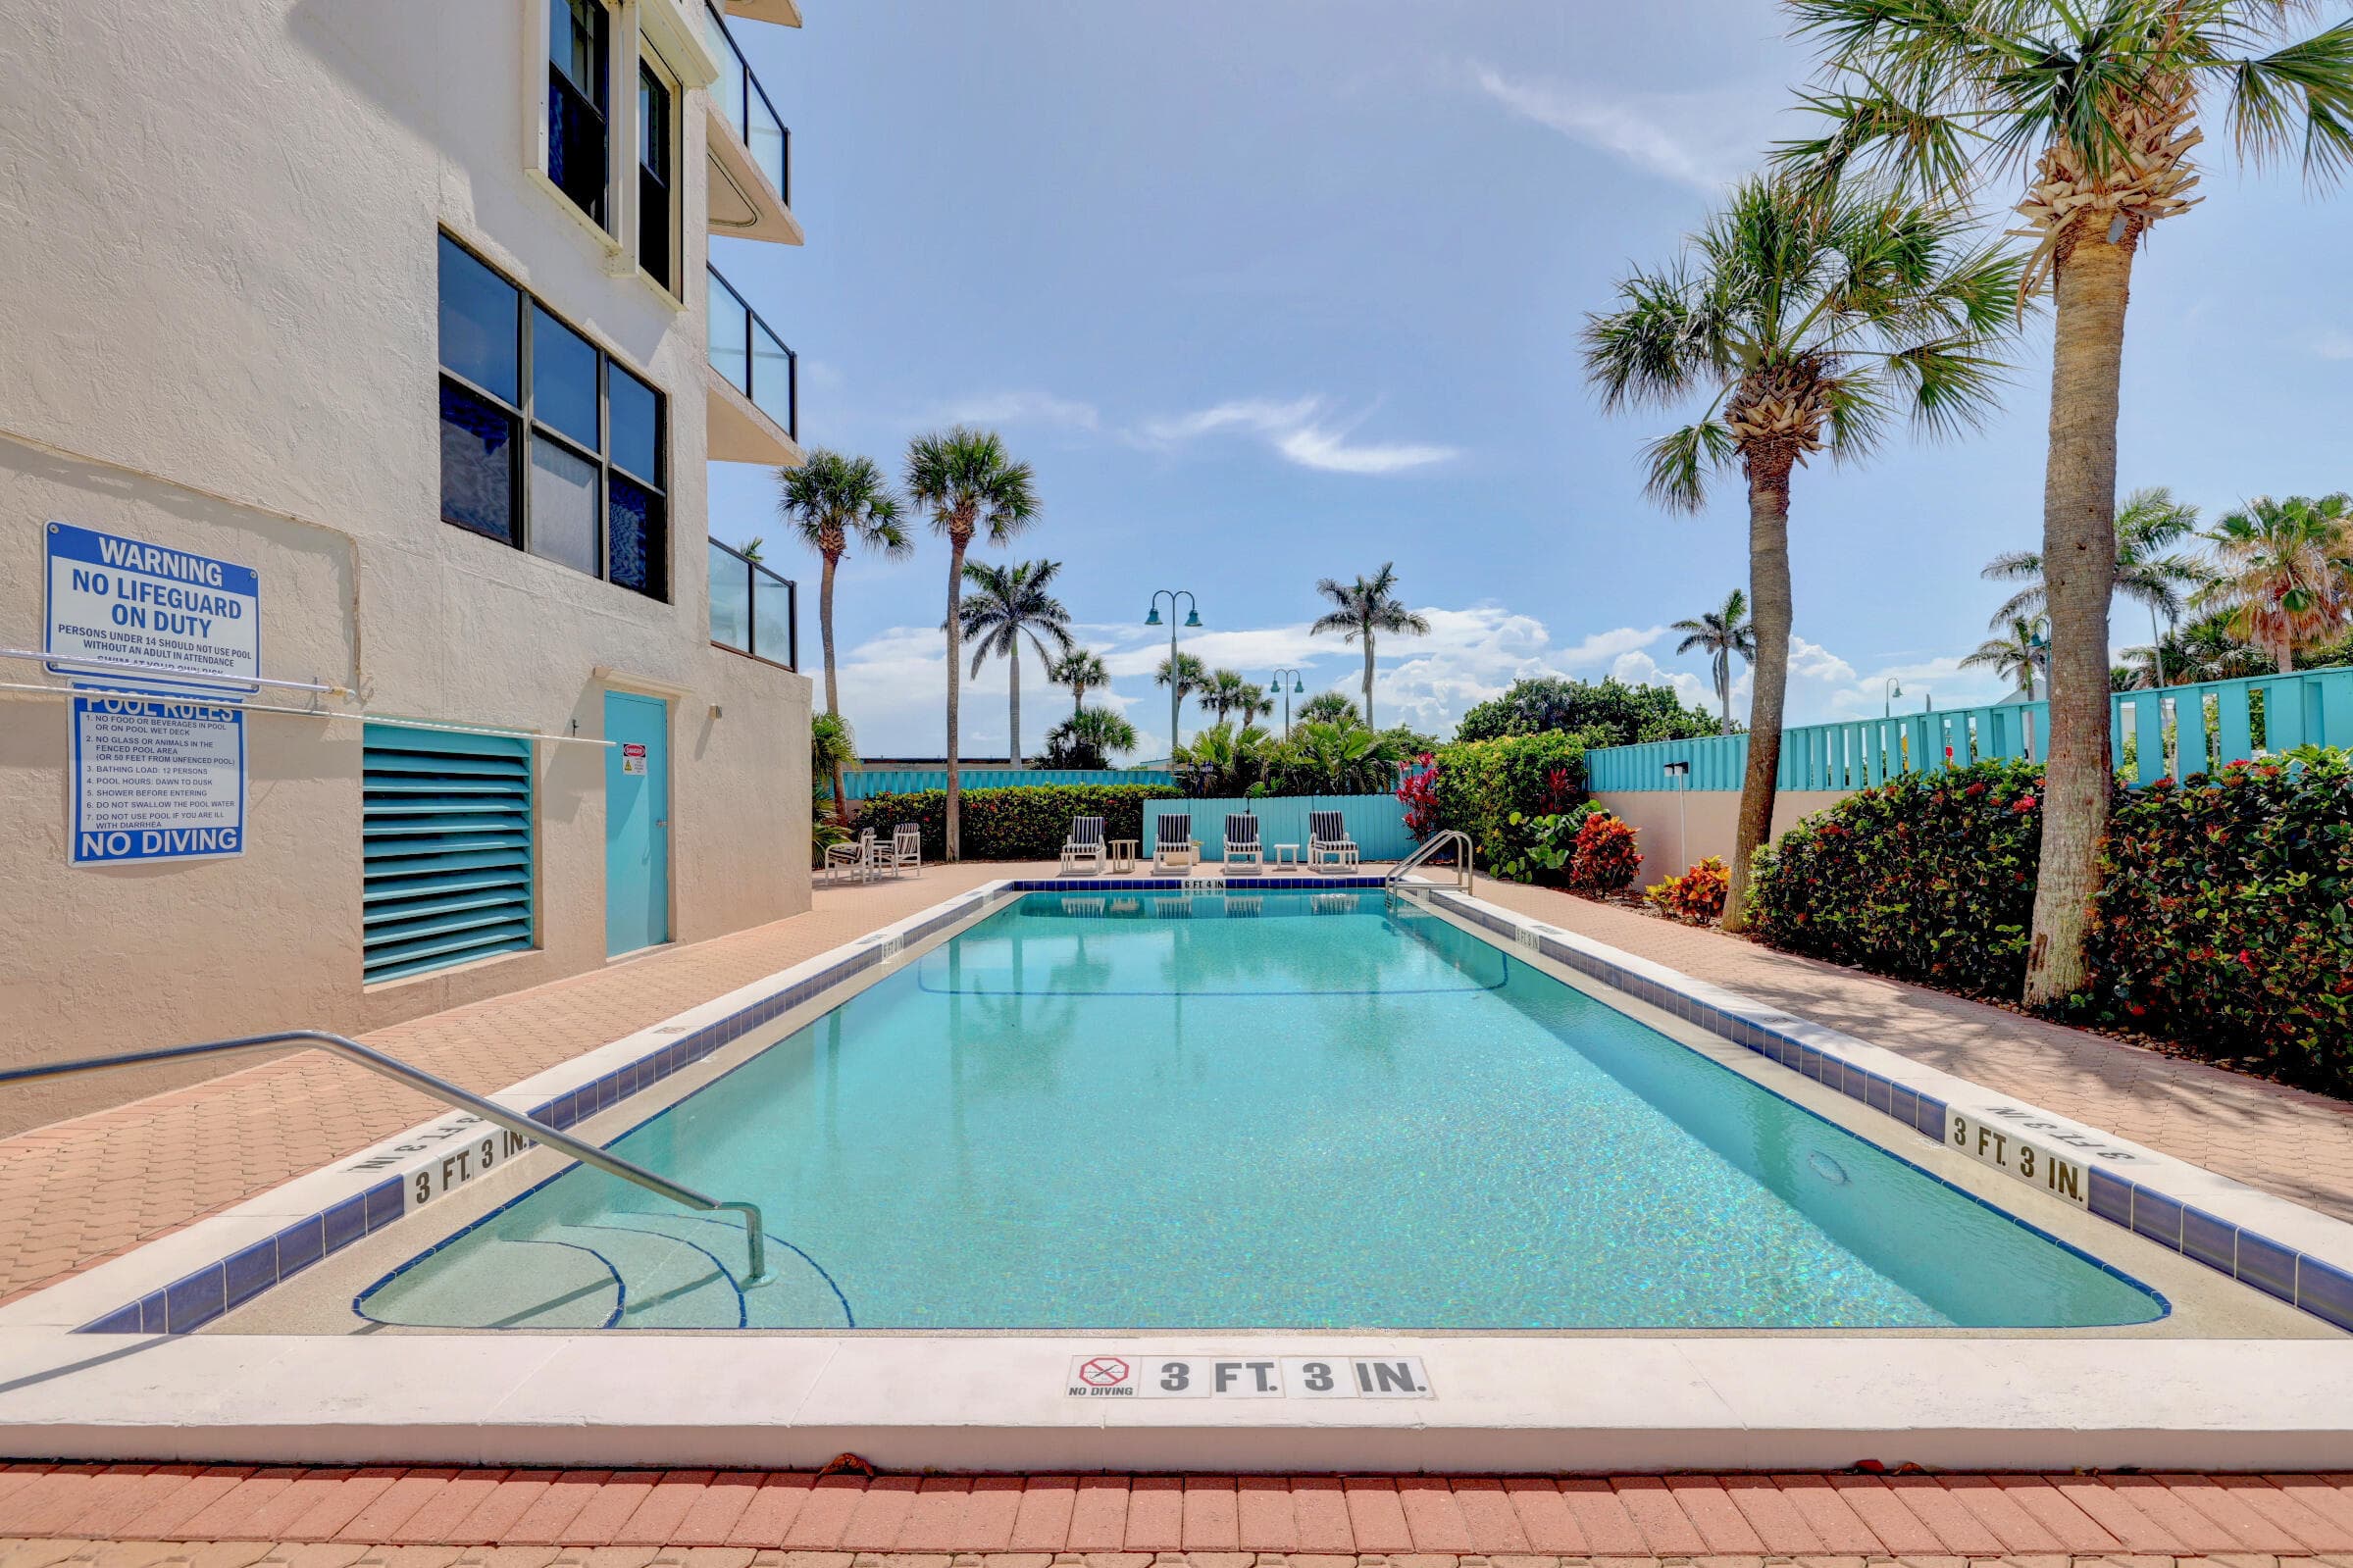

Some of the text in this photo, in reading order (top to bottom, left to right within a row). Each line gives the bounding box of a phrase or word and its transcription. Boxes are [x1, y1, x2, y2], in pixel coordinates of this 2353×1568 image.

[98, 536, 224, 587] WARNING
[73, 568, 242, 620] NO LIFEGUARD
[112, 603, 212, 638] ON DUTY
[59, 624, 251, 659] PERSONS UNDER 14 SHOULD NOT USE POOL
[83, 639, 127, 652] WITHOUT
[128, 646, 141, 655] AN
[143, 647, 172, 658] ADULT
[174, 651, 181, 660] IN
[183, 653, 234, 667] ATTENDANCE
[86, 687, 233, 722] POOL RULES
[81, 828, 237, 857] NO DIVING
[416, 1130, 528, 1204] 3 FT. 3 IN.
[1954, 1117, 2083, 1202] 3 FT. 3 IN.
[1068, 1387, 1133, 1395] NO DIVING
[1159, 1362, 1426, 1392] 3 FT. 3 IN.
